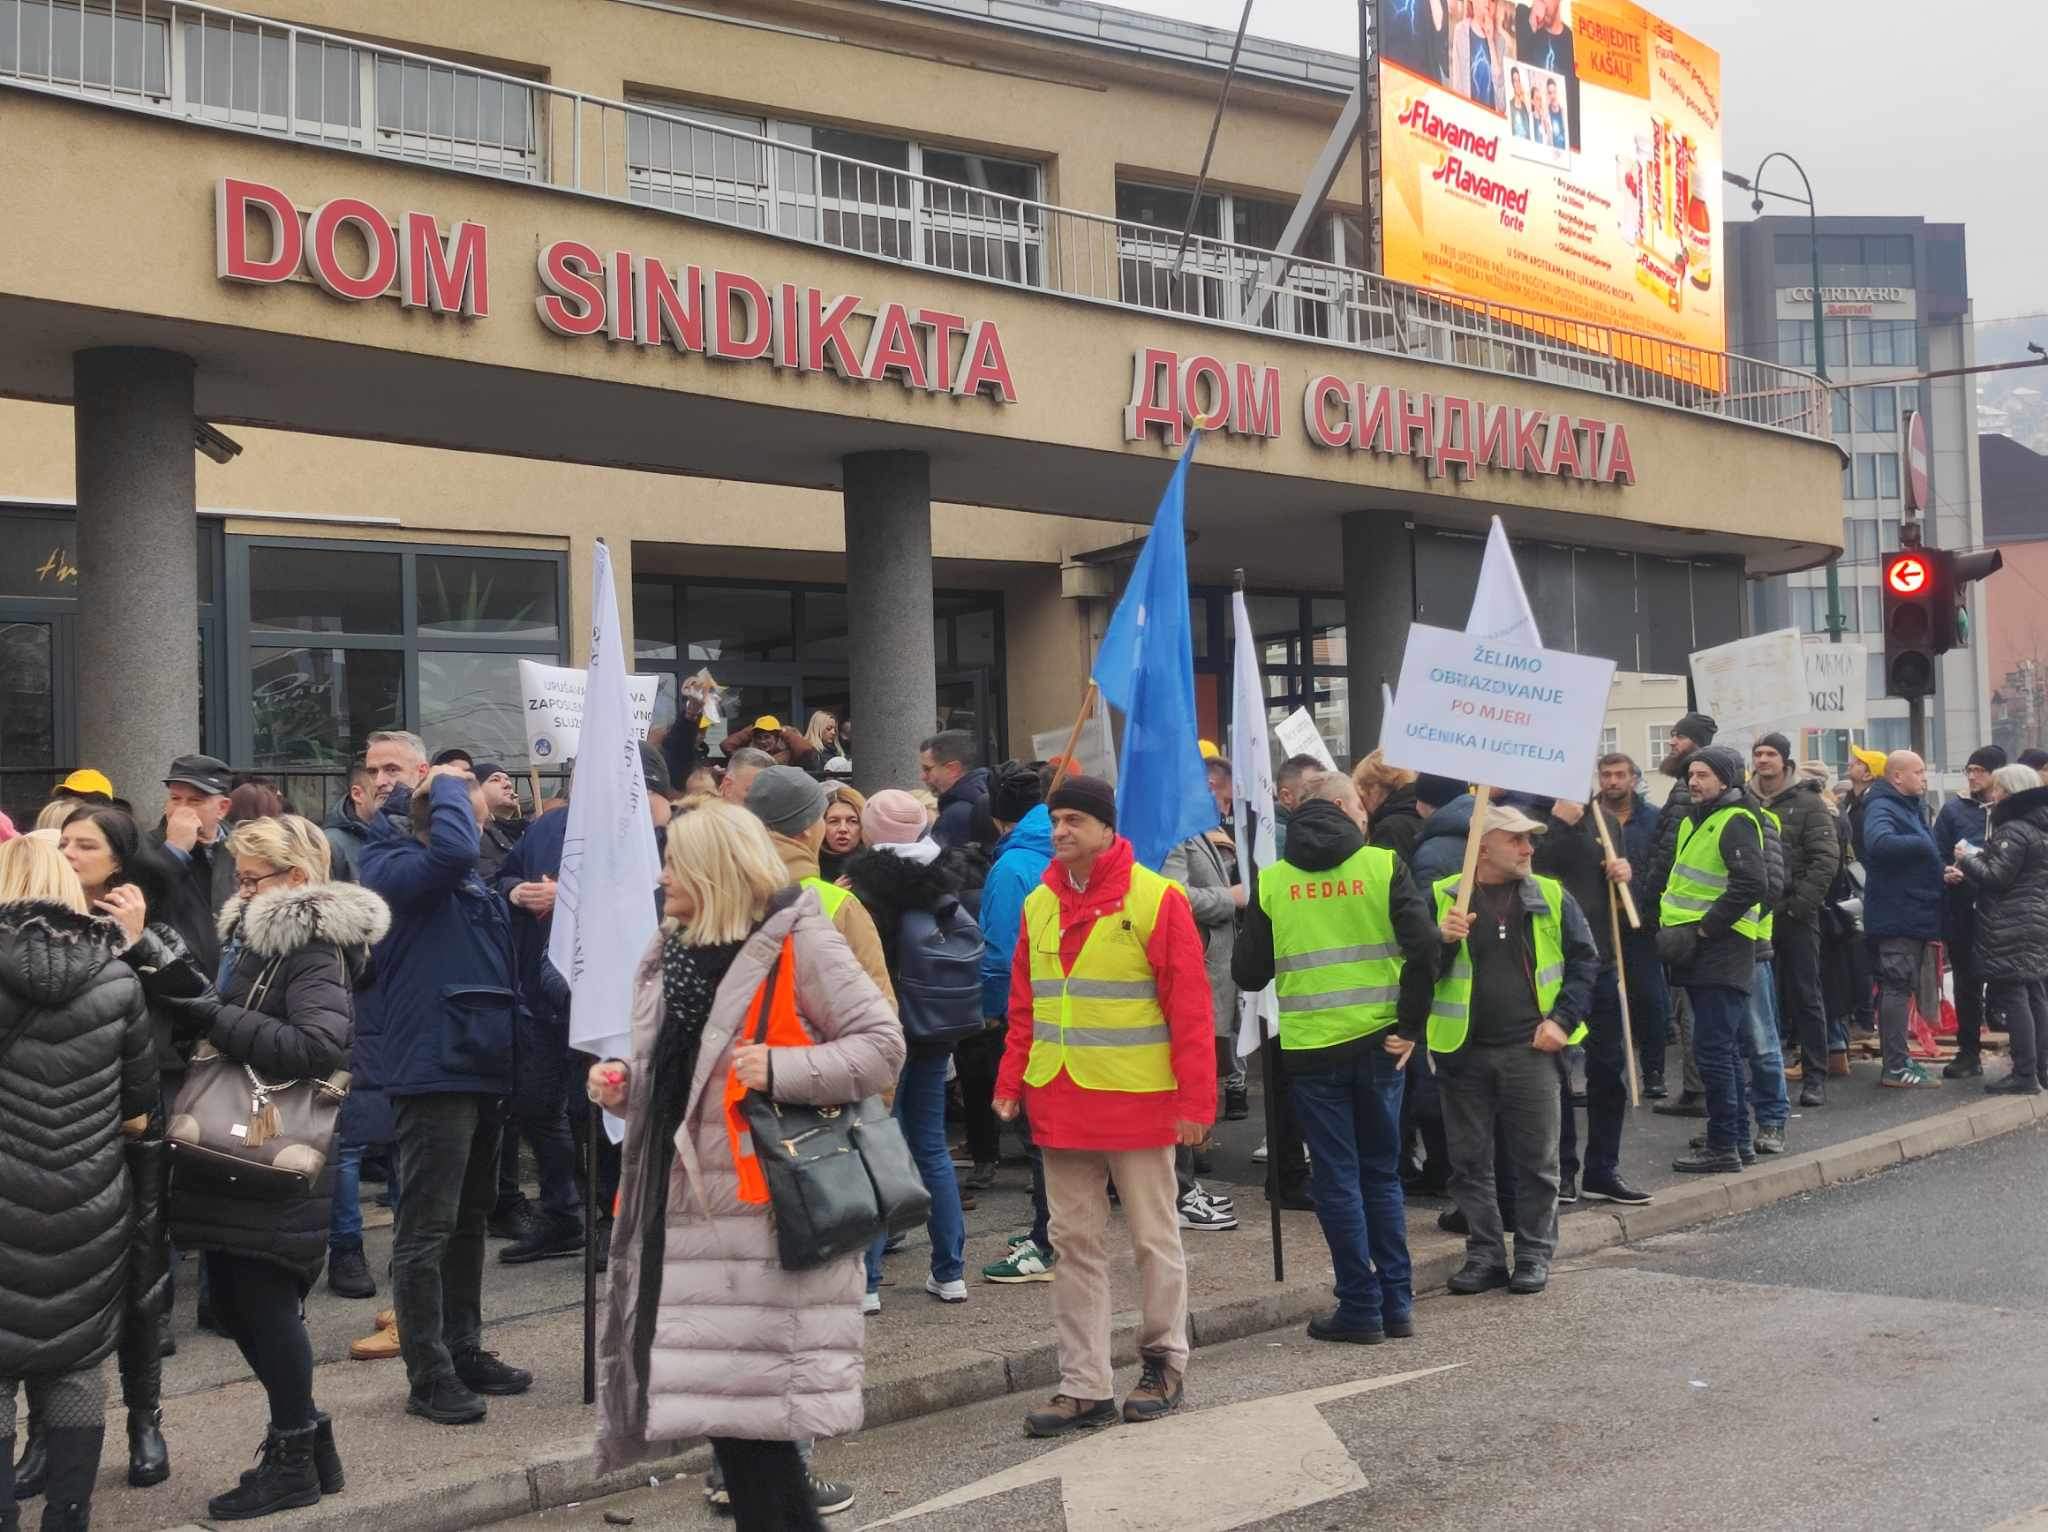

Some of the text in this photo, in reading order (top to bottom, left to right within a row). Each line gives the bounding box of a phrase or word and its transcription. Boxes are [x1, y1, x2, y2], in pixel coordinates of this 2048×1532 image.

[1408, 99, 1499, 163] Flavamed
[1443, 155, 1530, 216] Flavamed
[1500, 209, 1525, 233] forte
[215, 176, 490, 319] DOM
[536, 240, 1019, 404] SINDIKATA
[1125, 346, 1281, 446] ДОМ
[1304, 374, 1637, 484] СИНДИКАТА
[1473, 645, 1543, 673] ŽELIMO
[1428, 667, 1565, 705] OBRAZOVANJE
[1450, 699, 1533, 727] PO MJERI
[1406, 722, 1478, 749] UČENIKA
[1489, 737, 1567, 764] UČITELJA
[1290, 879, 1366, 901] REDAR
